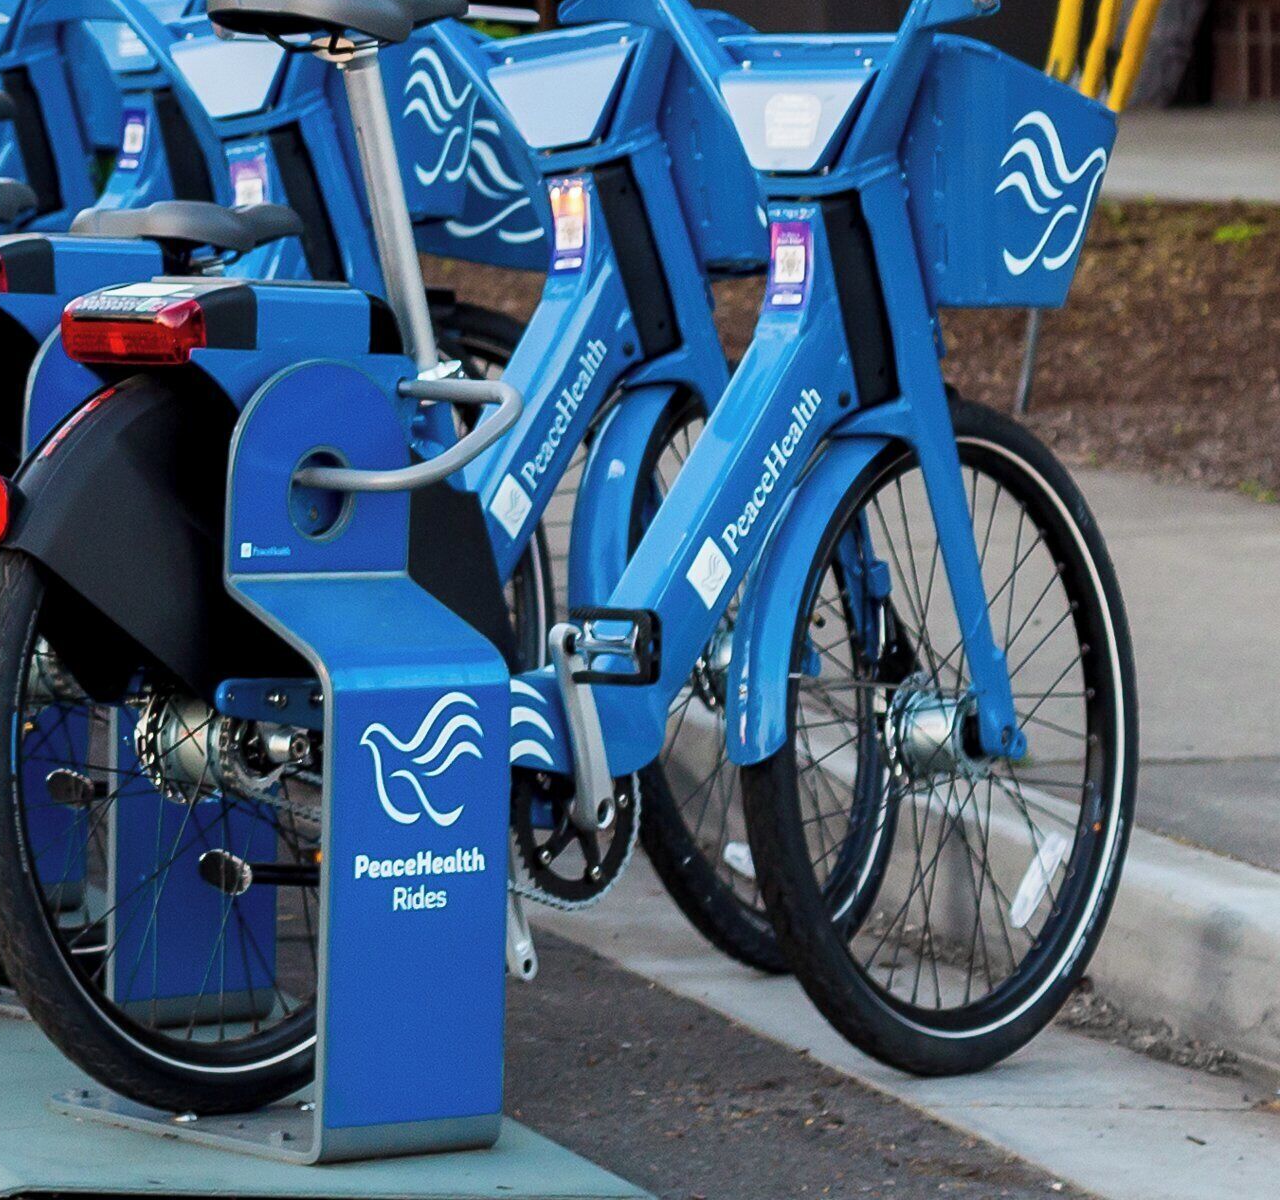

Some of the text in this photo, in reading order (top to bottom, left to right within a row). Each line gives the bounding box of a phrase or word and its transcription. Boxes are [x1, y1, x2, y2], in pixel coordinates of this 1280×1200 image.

[521, 337, 608, 491] PeaceHealth
[721, 387, 823, 555] PeaceHealth
[354, 846, 486, 880] PeaceHealth
[392, 883, 448, 912] Rides
